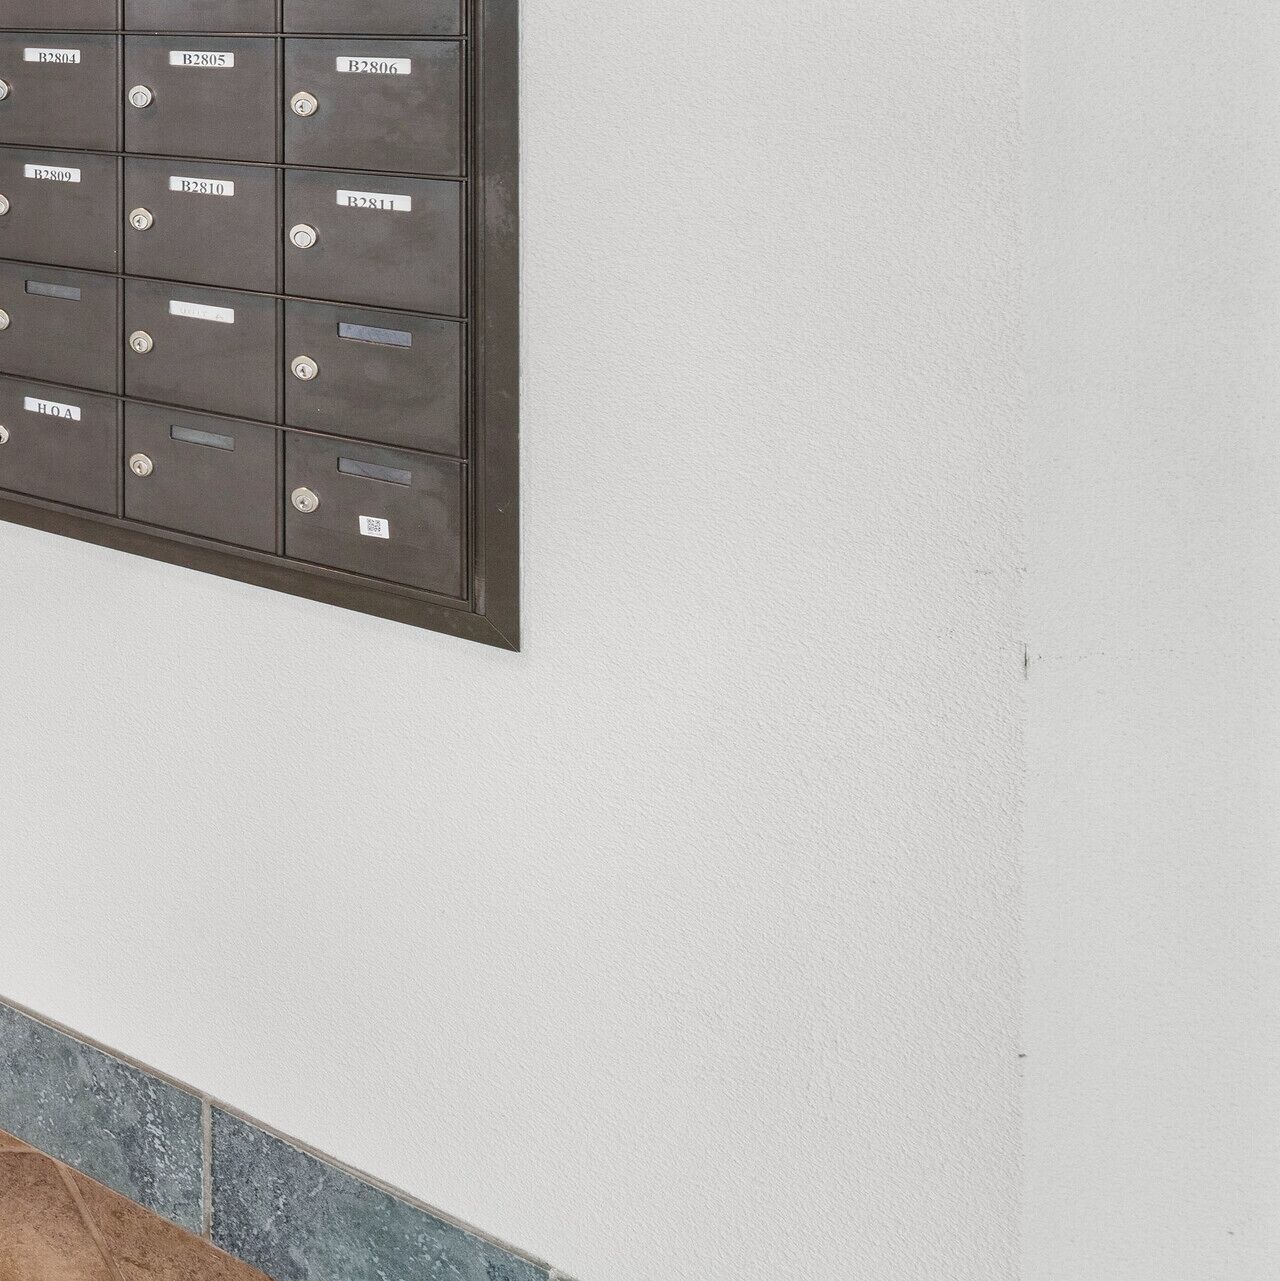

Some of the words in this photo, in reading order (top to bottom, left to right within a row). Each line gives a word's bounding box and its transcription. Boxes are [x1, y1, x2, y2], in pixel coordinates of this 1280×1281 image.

[38, 52, 76, 63] B2804
[182, 53, 225, 66] B2805
[348, 60, 397, 74] B2806
[34, 169, 72, 182] B2809
[181, 180, 224, 195] B2810
[347, 196, 395, 210] B2811
